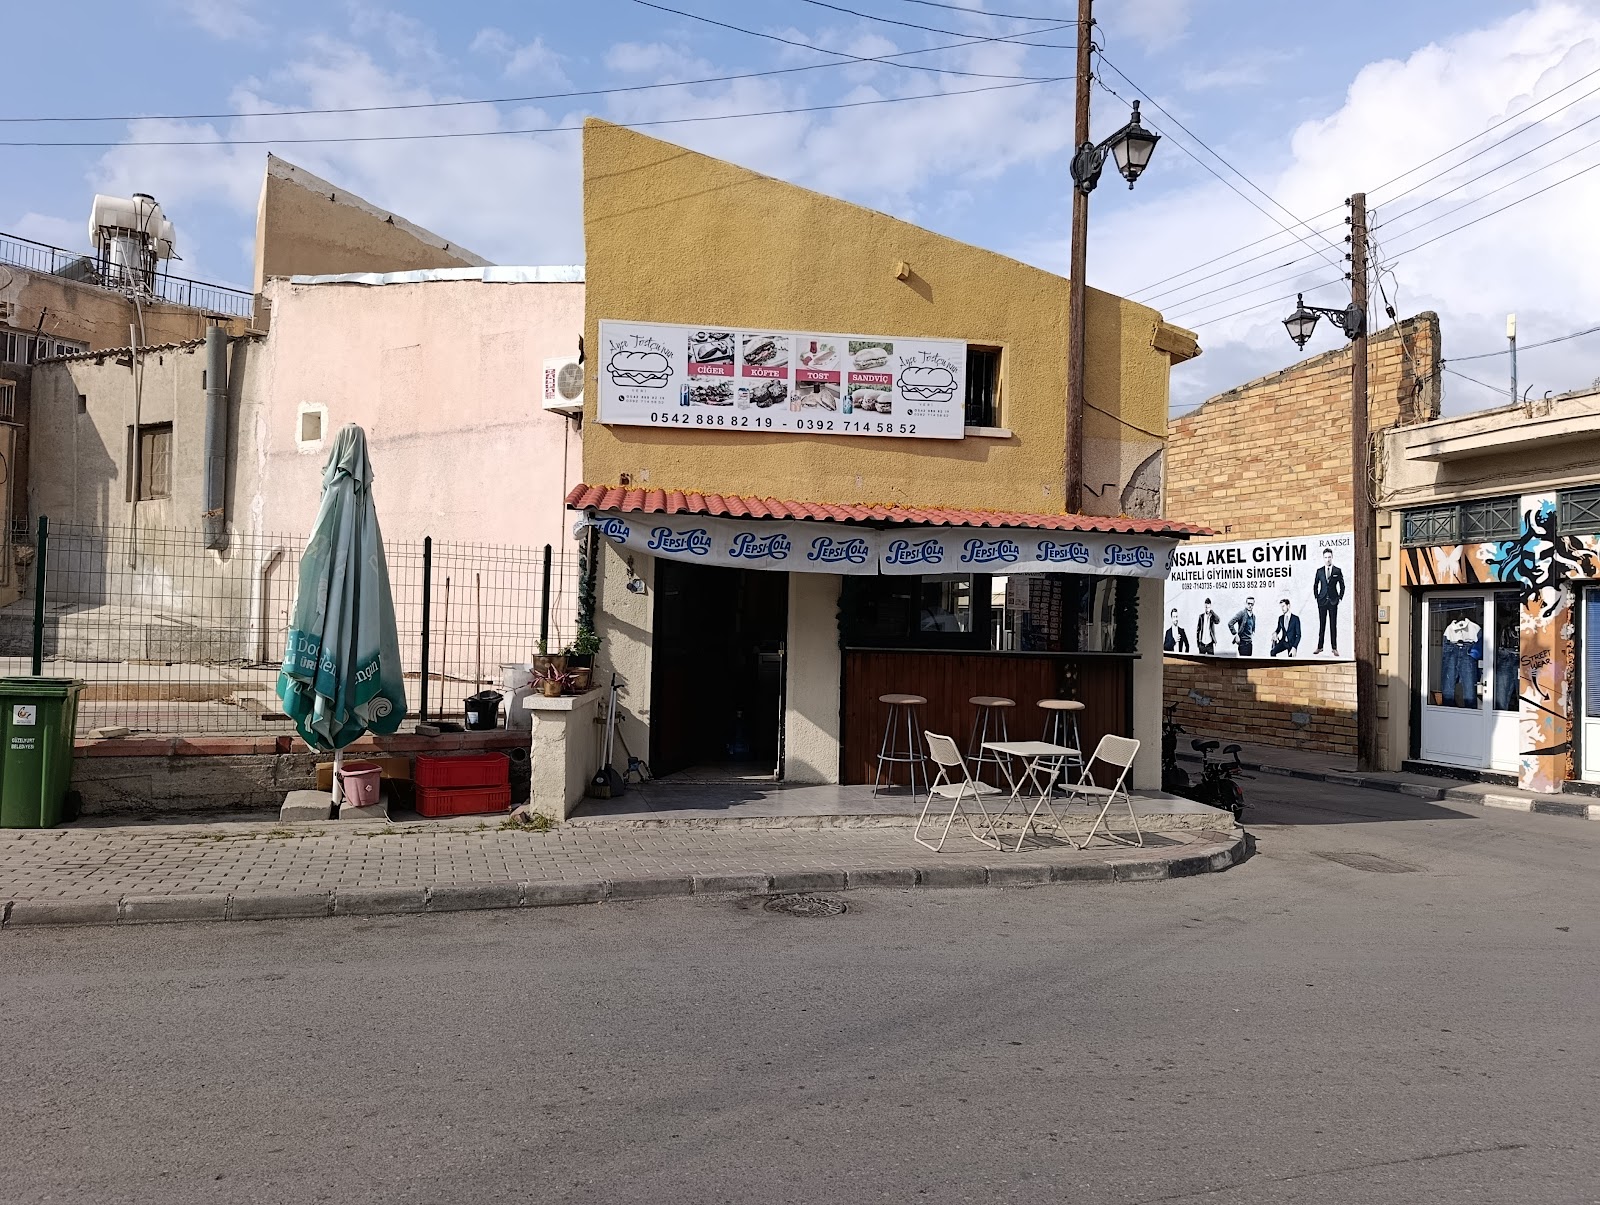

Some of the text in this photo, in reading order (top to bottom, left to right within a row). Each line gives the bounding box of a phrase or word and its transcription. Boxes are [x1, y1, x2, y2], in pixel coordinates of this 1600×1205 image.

[697, 366, 724, 374] CİĞER
[750, 368, 780, 377] KÖFTE
[852, 374, 888, 384] SANDVİÇ
[650, 412, 689, 424] 0542
[696, 415, 724, 425] 888
[731, 416, 748, 426] 82
[756, 417, 772, 427] 19
[797, 419, 834, 430] 0392
[844, 421, 870, 432] 714
[877, 423, 893, 433] 58
[899, 424, 916, 434] 52
[1206, 548, 1247, 565] AKEL
[1252, 541, 1307, 562] GİYİM
[1171, 565, 1292, 581] KALİTELİ GİYİMİN SİMGESİ
[1521, 649, 1551, 666] STREET
[1530, 658, 1552, 670] WEAR
